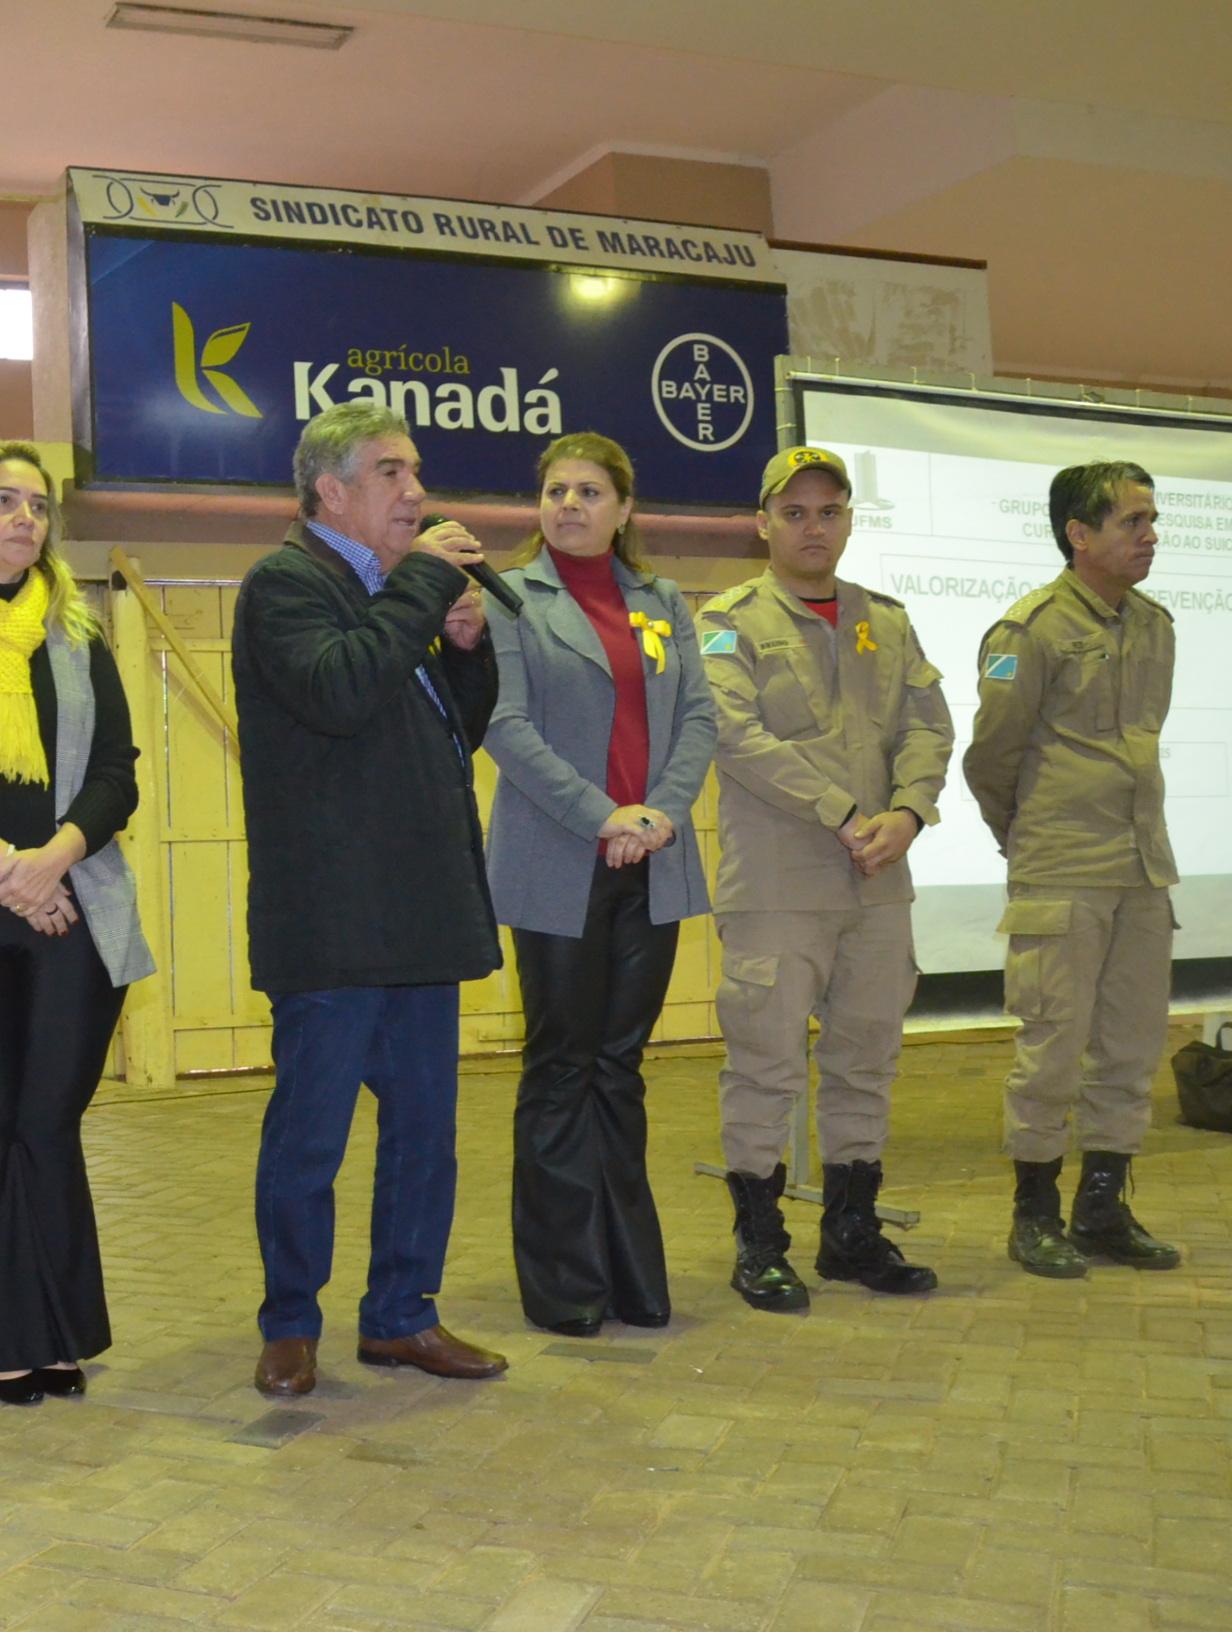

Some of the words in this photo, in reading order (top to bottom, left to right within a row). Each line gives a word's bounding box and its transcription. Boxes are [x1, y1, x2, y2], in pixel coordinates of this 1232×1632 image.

[250, 197, 424, 234] SINDICATO
[433, 212, 540, 246] RURAL
[545, 225, 589, 251] DE
[596, 230, 756, 267] MARACAJU
[347, 344, 471, 376] agrícola
[661, 380, 746, 404] BAYER
[693, 344, 715, 441] BAYER
[1183, 535, 1201, 549] AO
[890, 573, 1033, 604] VALORIZAÇÃO
